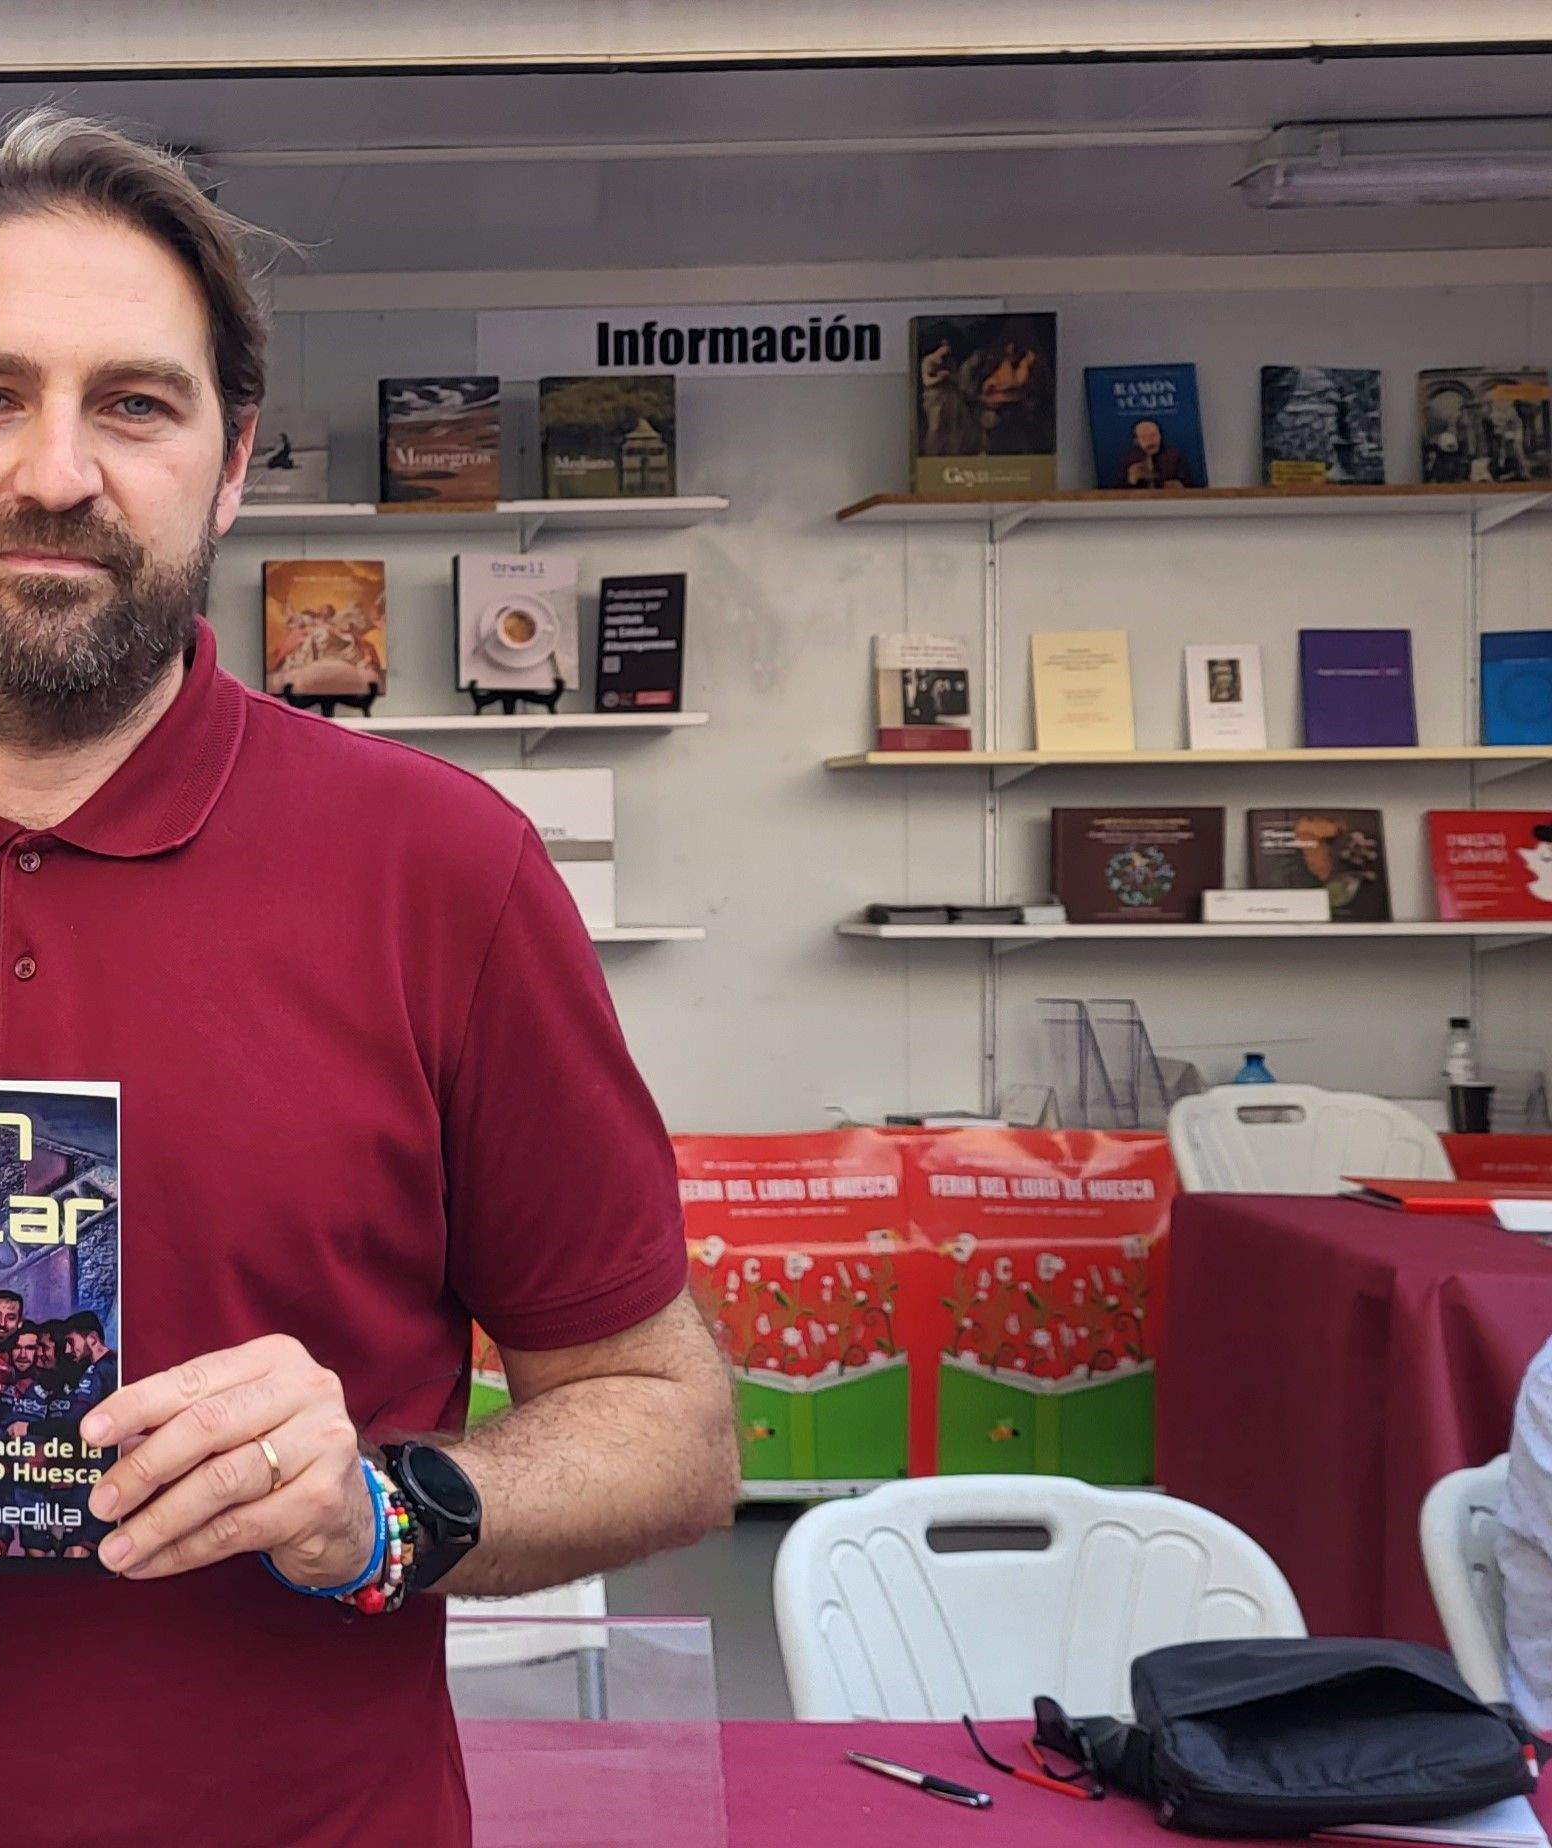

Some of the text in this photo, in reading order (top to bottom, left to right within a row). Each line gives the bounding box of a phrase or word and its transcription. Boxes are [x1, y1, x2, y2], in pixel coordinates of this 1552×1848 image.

[597, 314, 881, 366] Información
[395, 446, 492, 469] Monegros
[491, 561, 545, 573] Orwell
[43, 1437, 74, 1459] de
[81, 1438, 103, 1459] la
[13, 1462, 102, 1485] Huesca
